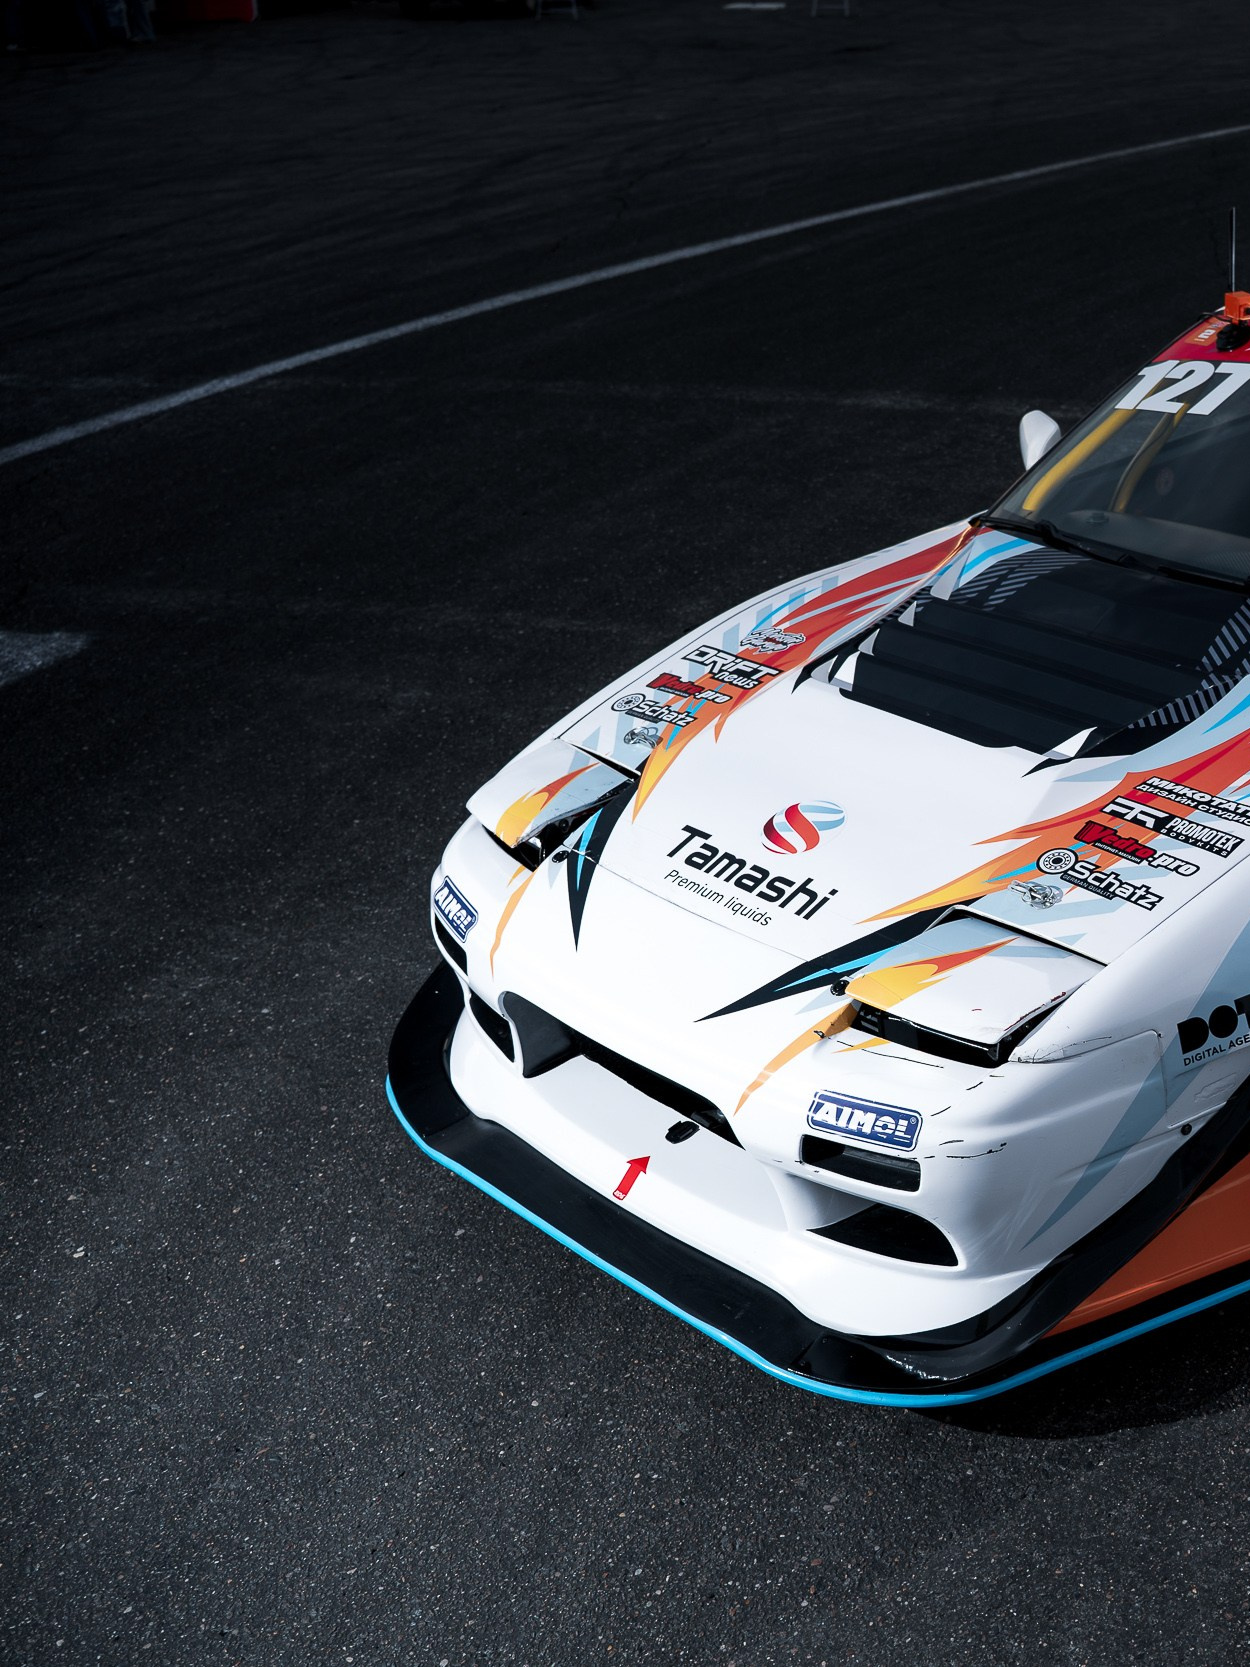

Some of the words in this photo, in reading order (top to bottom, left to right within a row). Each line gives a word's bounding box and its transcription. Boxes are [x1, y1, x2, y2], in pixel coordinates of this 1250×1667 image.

[649, 674, 731, 704] Vedro.pro
[714, 671, 759, 689] news
[632, 702, 696, 727] Schatz
[1135, 784, 1197, 807] ДИЗАЙН
[1076, 822, 1199, 876] Vedro.pro
[1160, 829, 1228, 857] BODYKITS
[1165, 817, 1240, 852] PROMOTEK
[666, 824, 839, 921] Tamashi
[1062, 874, 1089, 890] GERMAN
[1087, 885, 1115, 899] QUALITY
[1067, 861, 1162, 909] Schatz
[664, 869, 725, 904] Premium
[723, 896, 772, 926] liquids
[1183, 1044, 1226, 1067] DIGITAL
[813, 1101, 912, 1143] AIMOL
